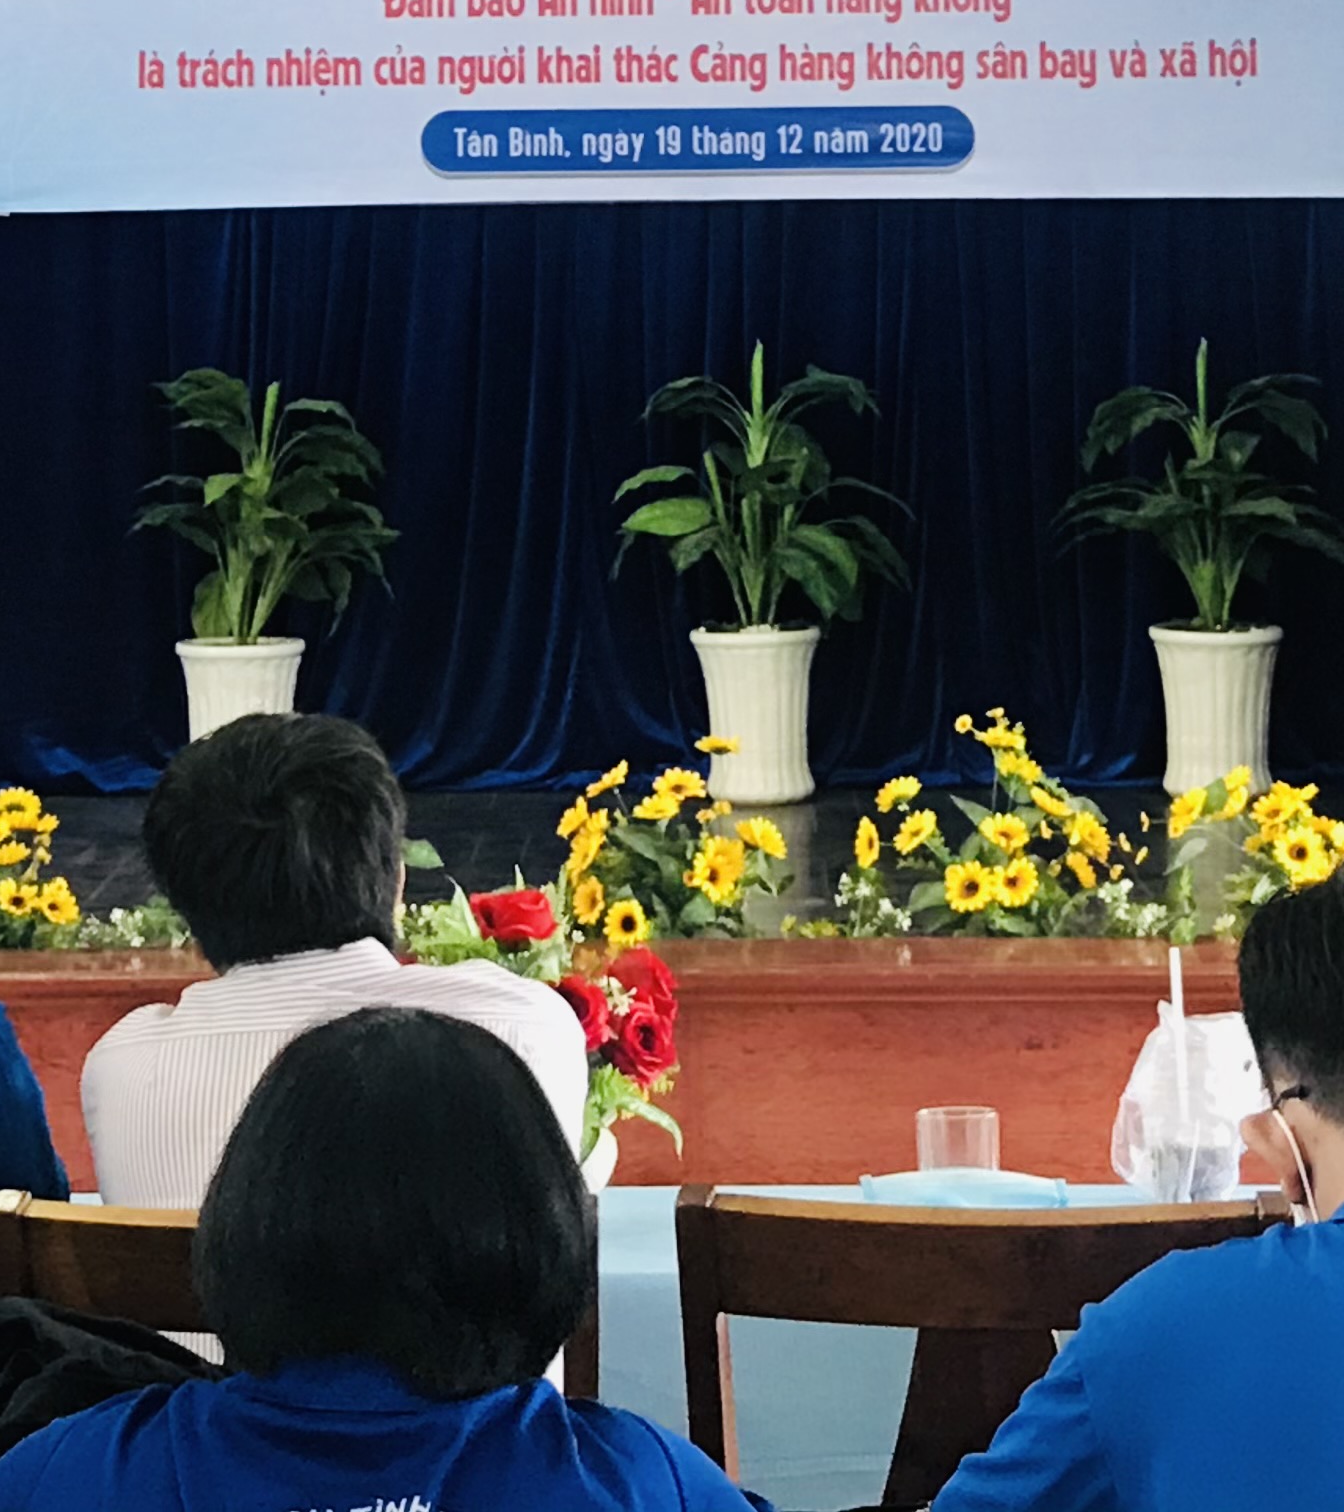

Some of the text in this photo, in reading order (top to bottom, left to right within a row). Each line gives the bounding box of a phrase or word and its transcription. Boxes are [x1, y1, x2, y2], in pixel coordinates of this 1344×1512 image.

[138, 37, 1258, 96] là trách nhiệm của người khai thác Cảng hàng không sân bay và xã hội
[453, 123, 944, 162] Tân Bình, ngày 19 tháng 12 năm 2020
